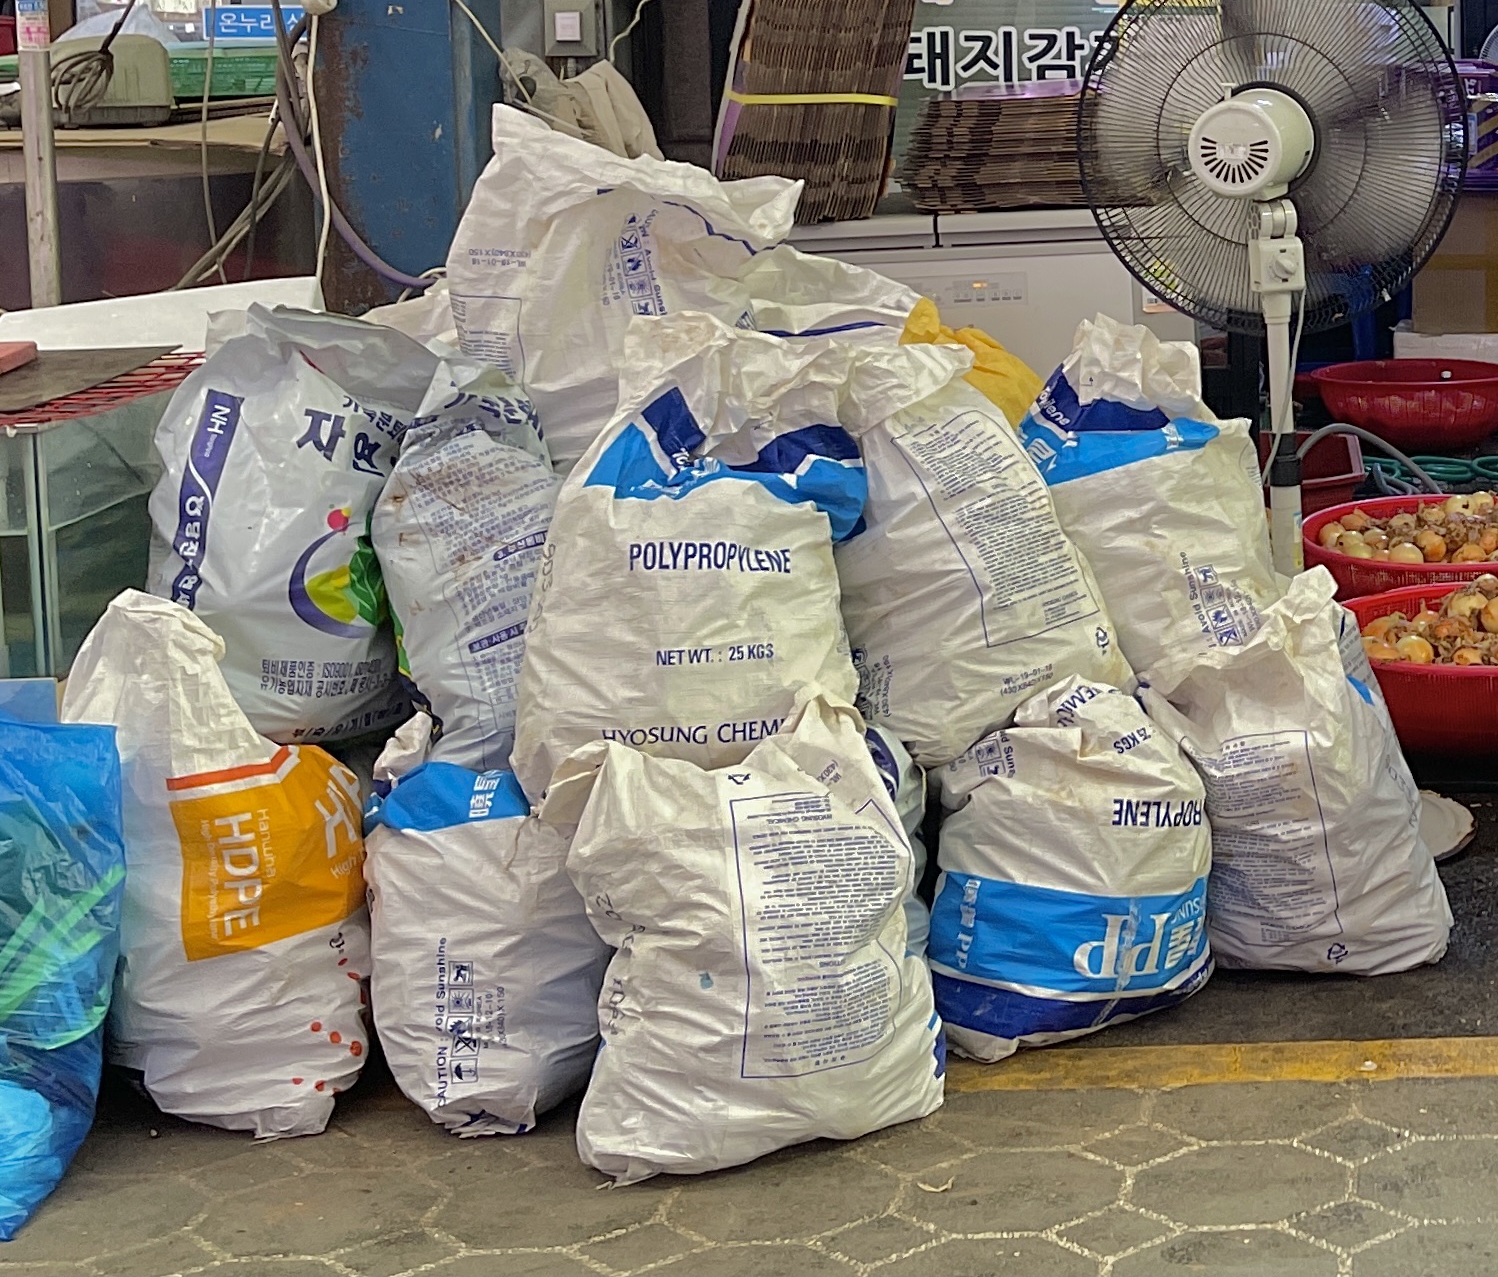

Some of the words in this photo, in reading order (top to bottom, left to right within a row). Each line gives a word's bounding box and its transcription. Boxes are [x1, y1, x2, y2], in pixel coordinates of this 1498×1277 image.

[207, 404, 232, 436] NH
[629, 541, 791, 574] POLYPROPYLENE
[656, 650, 686, 666] NET
[729, 646, 744, 661] 25
[747, 643, 774, 660] KGS
[602, 725, 708, 745] HYOSUNG
[215, 812, 262, 937] HDPE
[434, 936, 447, 1000] Sunshine
[435, 1046, 448, 1108] CAUTION
